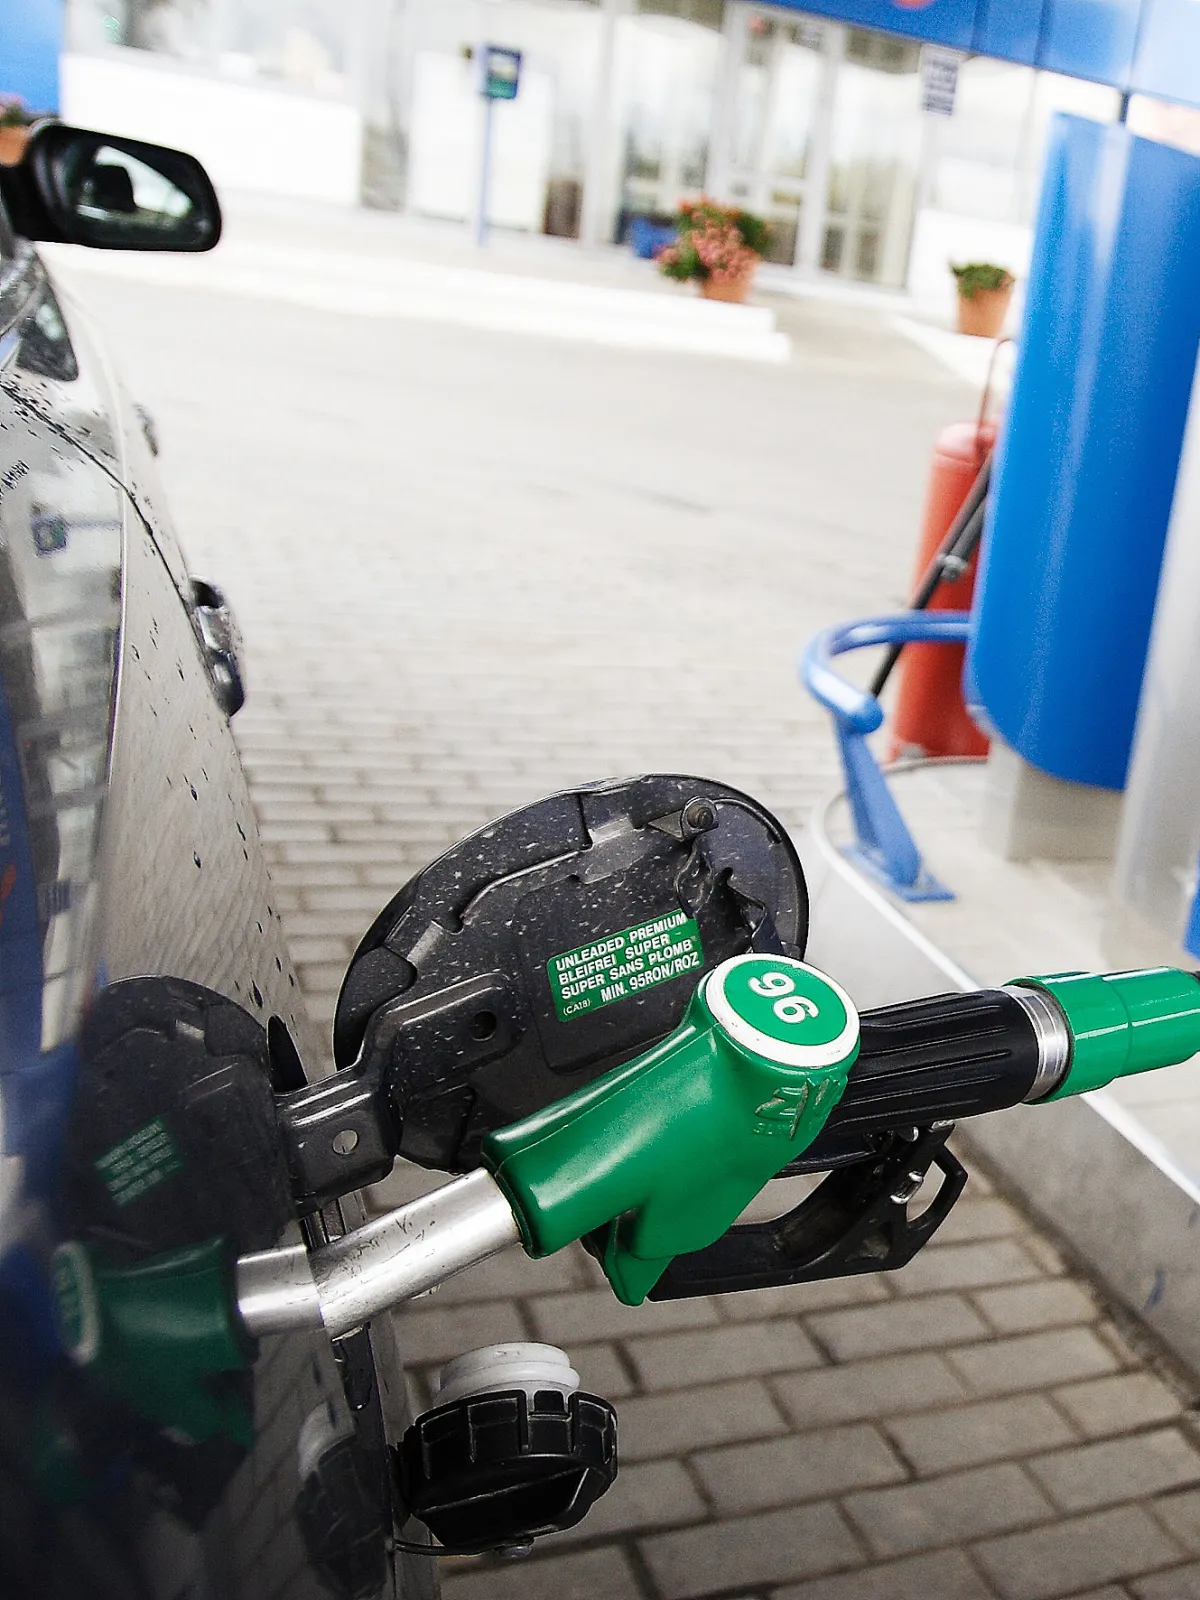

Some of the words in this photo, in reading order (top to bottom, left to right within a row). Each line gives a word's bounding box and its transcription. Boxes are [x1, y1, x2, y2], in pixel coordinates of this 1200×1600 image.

[555, 937, 625, 971] UNLEADED
[629, 912, 688, 942] PREMIUM
[558, 954, 617, 985] BLEIFREI
[625, 933, 670, 960] SUPER
[561, 974, 606, 999] SUPER
[609, 958, 644, 981] SANS
[648, 939, 692, 966] PLOMB
[600, 982, 629, 1002] MIN.
[629, 952, 700, 990] 95RON/ROZ
[749, 971, 820, 1024] 96
